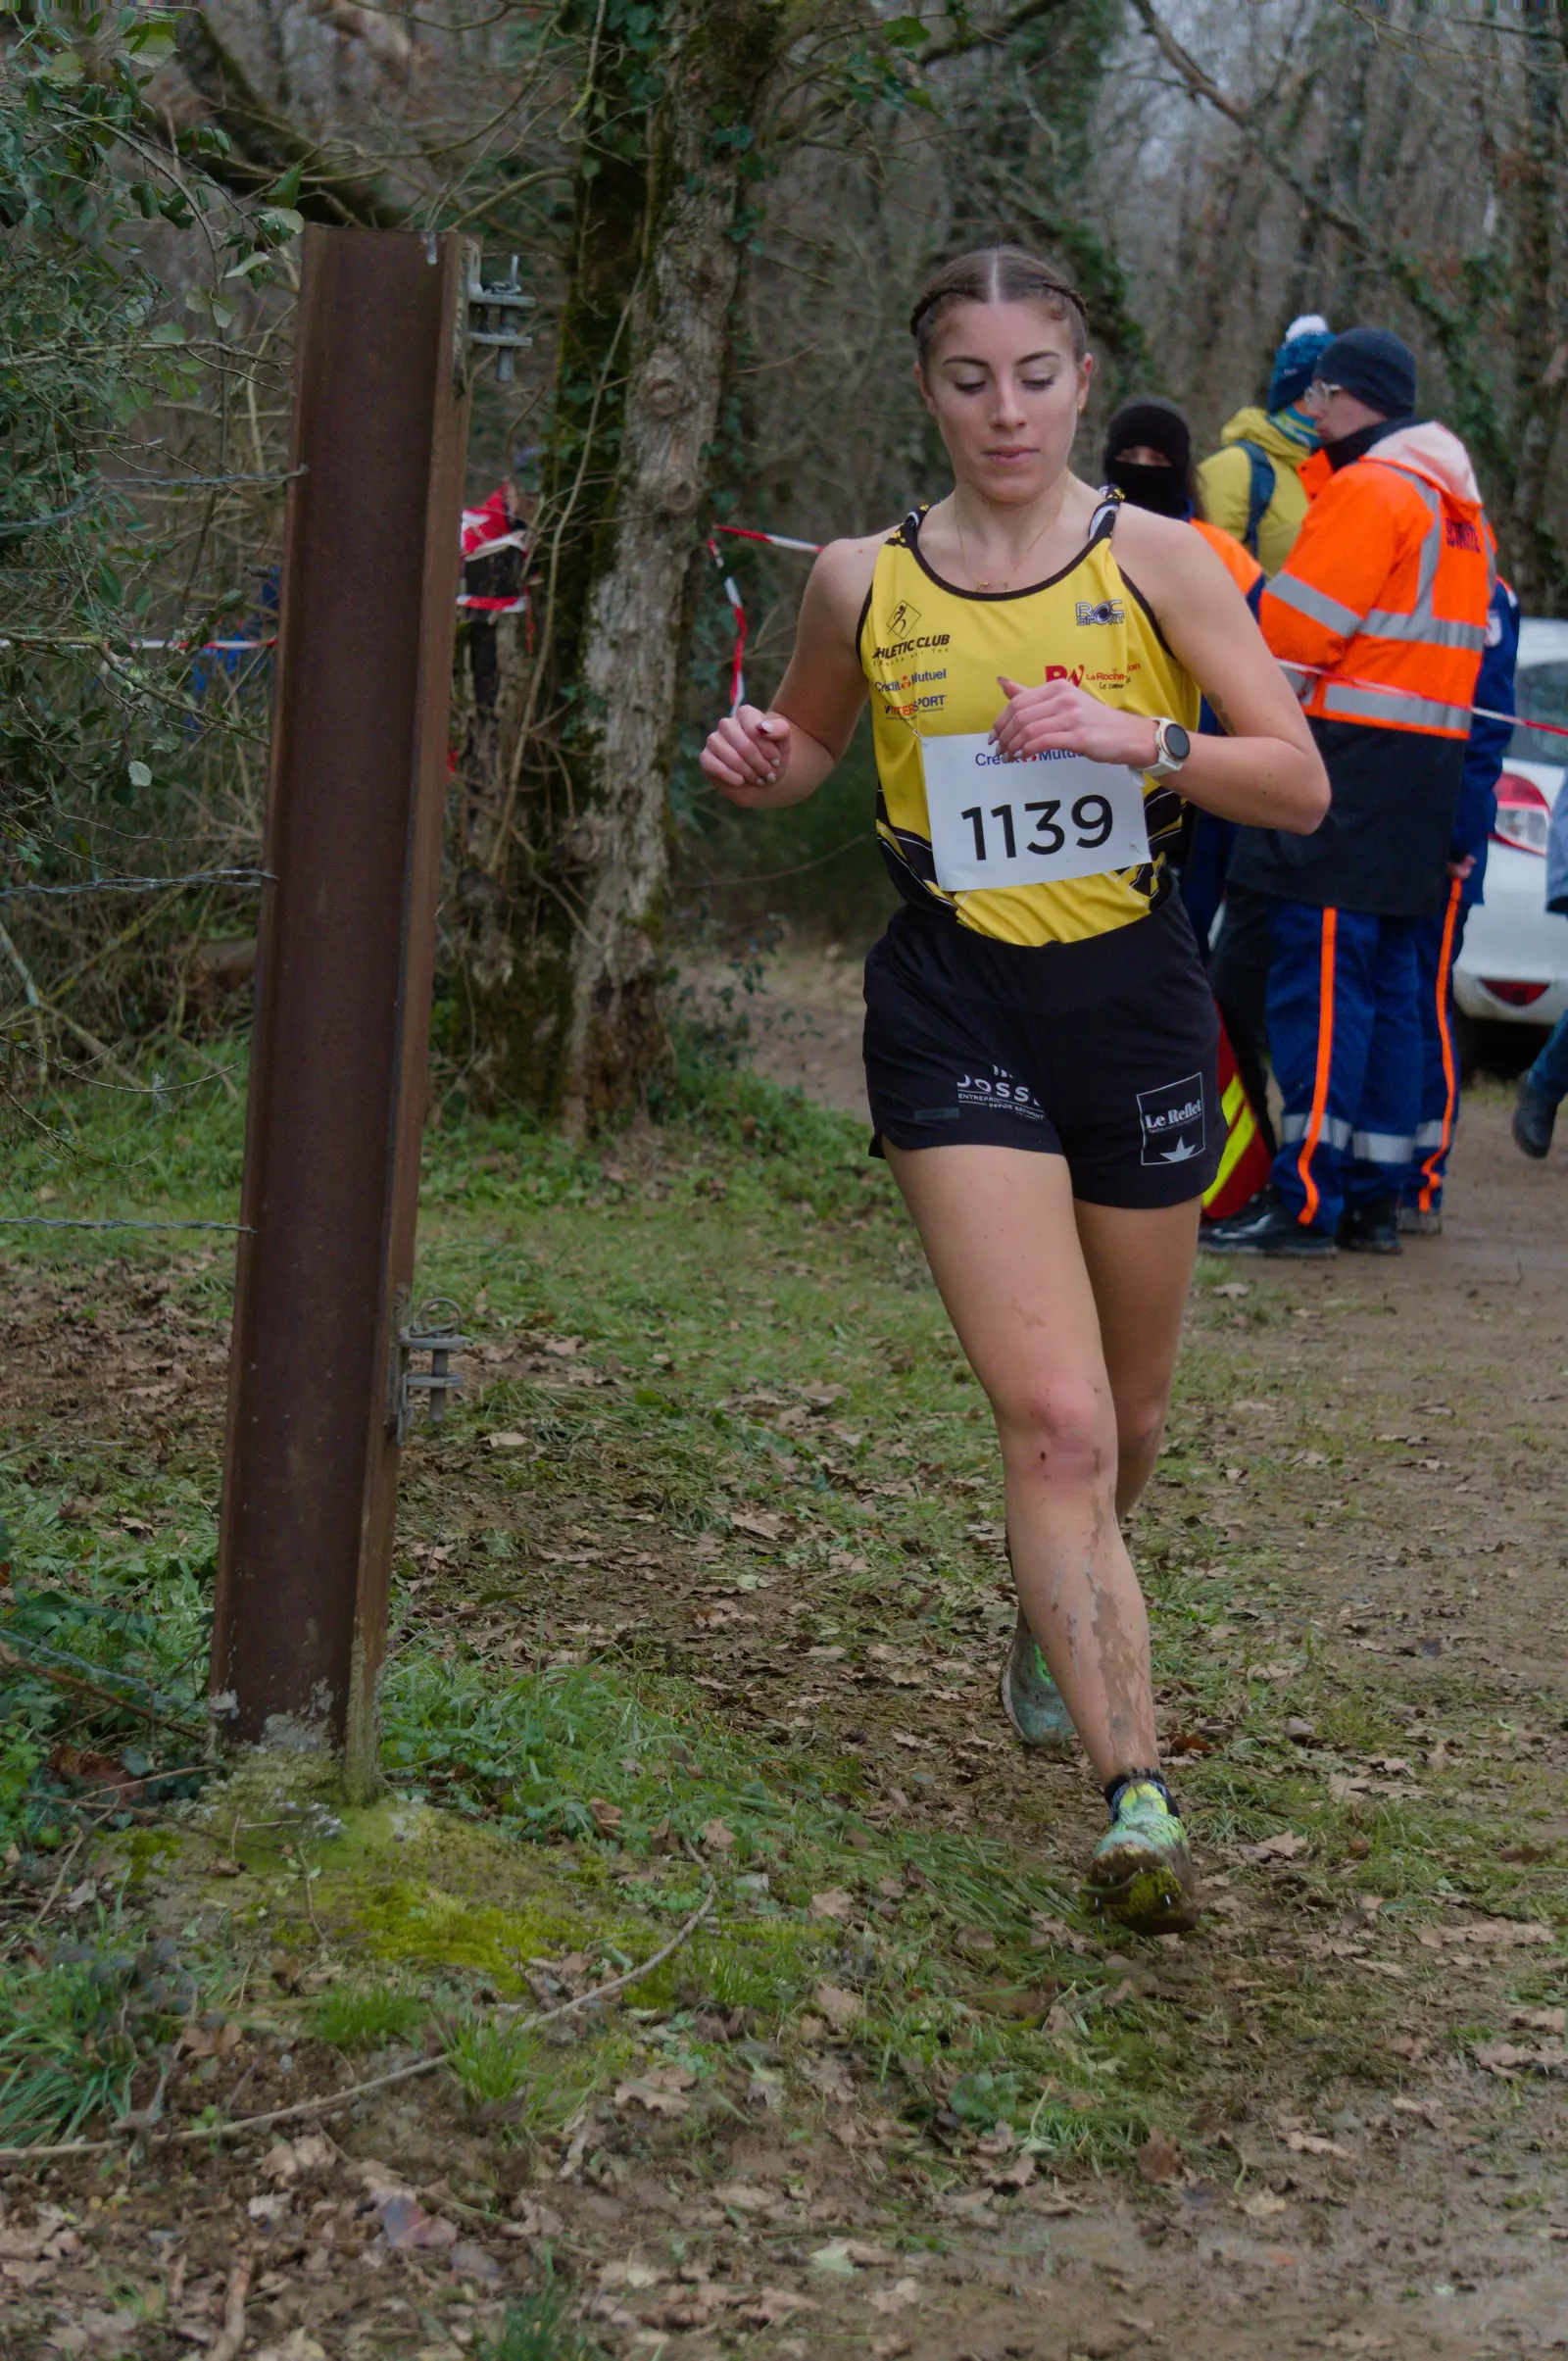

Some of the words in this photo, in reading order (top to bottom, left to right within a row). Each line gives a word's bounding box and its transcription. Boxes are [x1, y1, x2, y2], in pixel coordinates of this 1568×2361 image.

[916, 634, 950, 648] CLUB
[961, 795, 1113, 861] 1139
[956, 1074, 1040, 1107] JOSS
[1145, 1114, 1166, 1128] Le
[1167, 1099, 1201, 1124] Reflet
